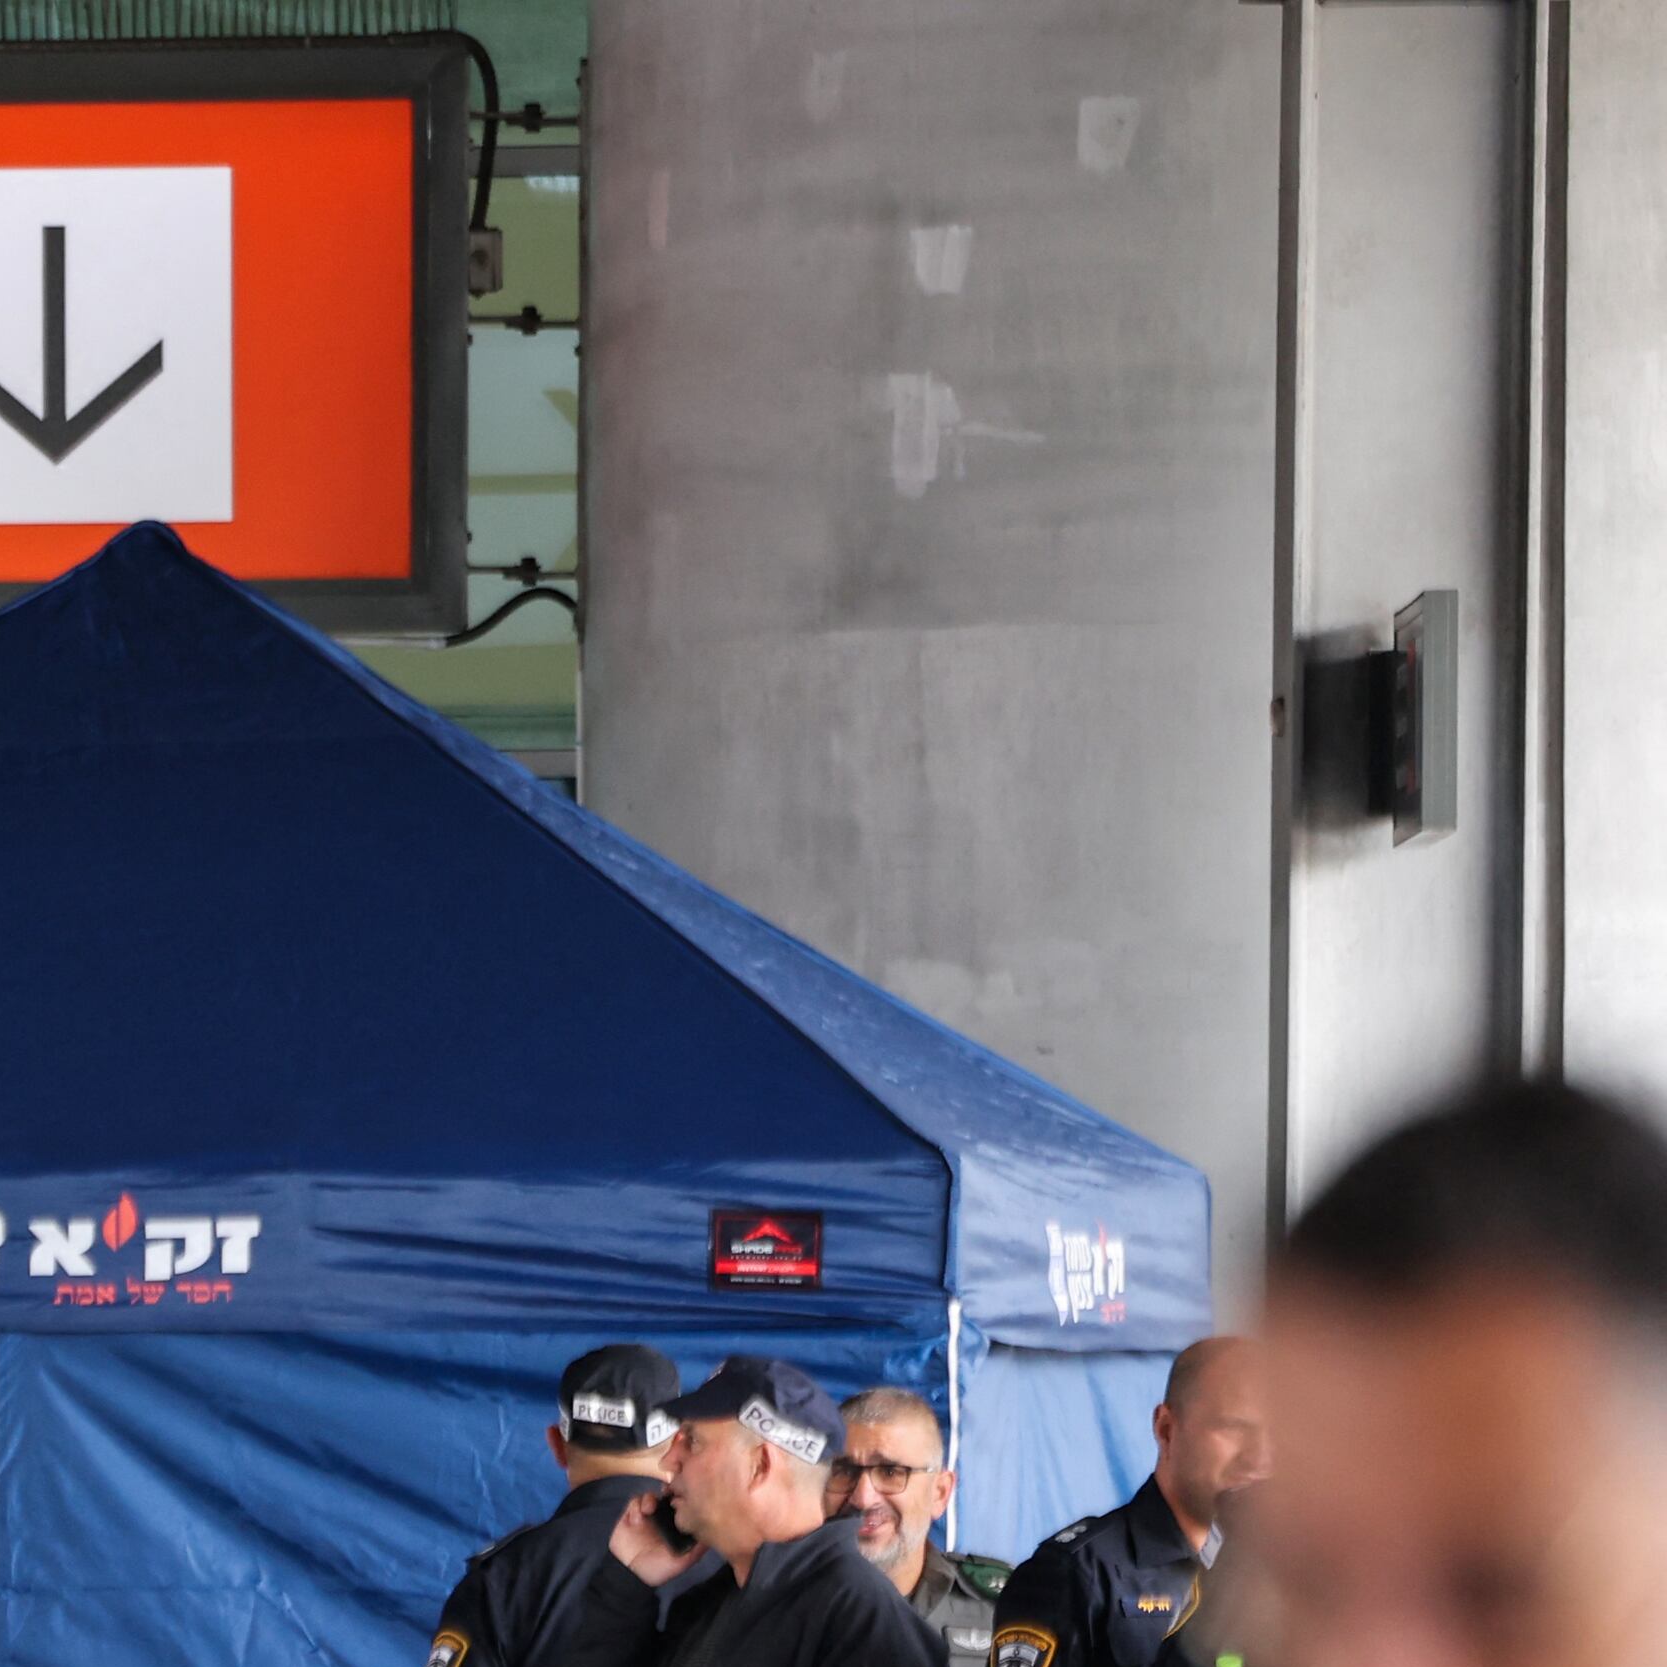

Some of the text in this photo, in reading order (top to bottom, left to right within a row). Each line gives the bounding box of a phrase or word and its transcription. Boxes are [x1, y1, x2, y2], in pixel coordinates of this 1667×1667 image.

[54, 1277, 233, 1306] חסד של אמת
[578, 1404, 625, 1423] PICE
[746, 1407, 820, 1459] POCE
